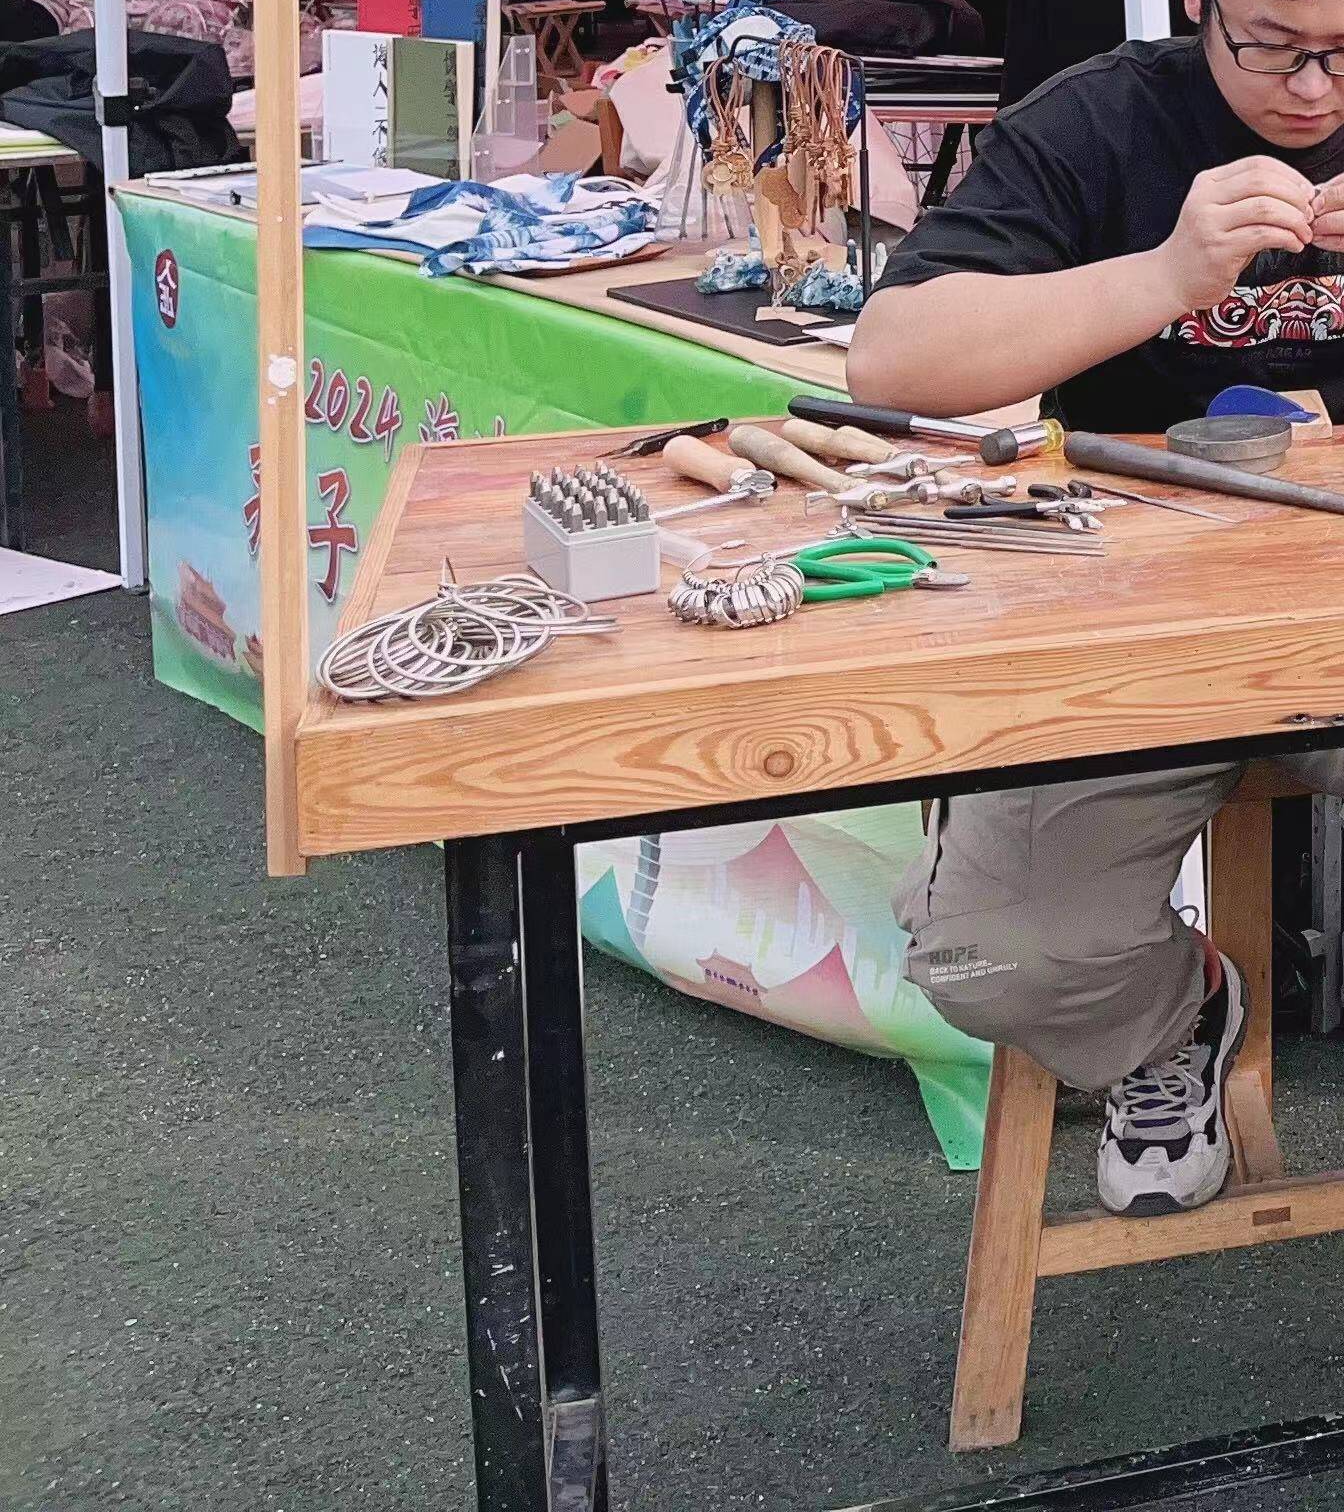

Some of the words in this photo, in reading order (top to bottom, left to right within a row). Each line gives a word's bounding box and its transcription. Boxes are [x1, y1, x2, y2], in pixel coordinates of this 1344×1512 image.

[304, 358, 402, 463] 2024
[928, 944, 978, 964] HOPE
[929, 966, 948, 975] BACK
[950, 965, 959, 973] TO
[970, 967, 987, 978] AND
